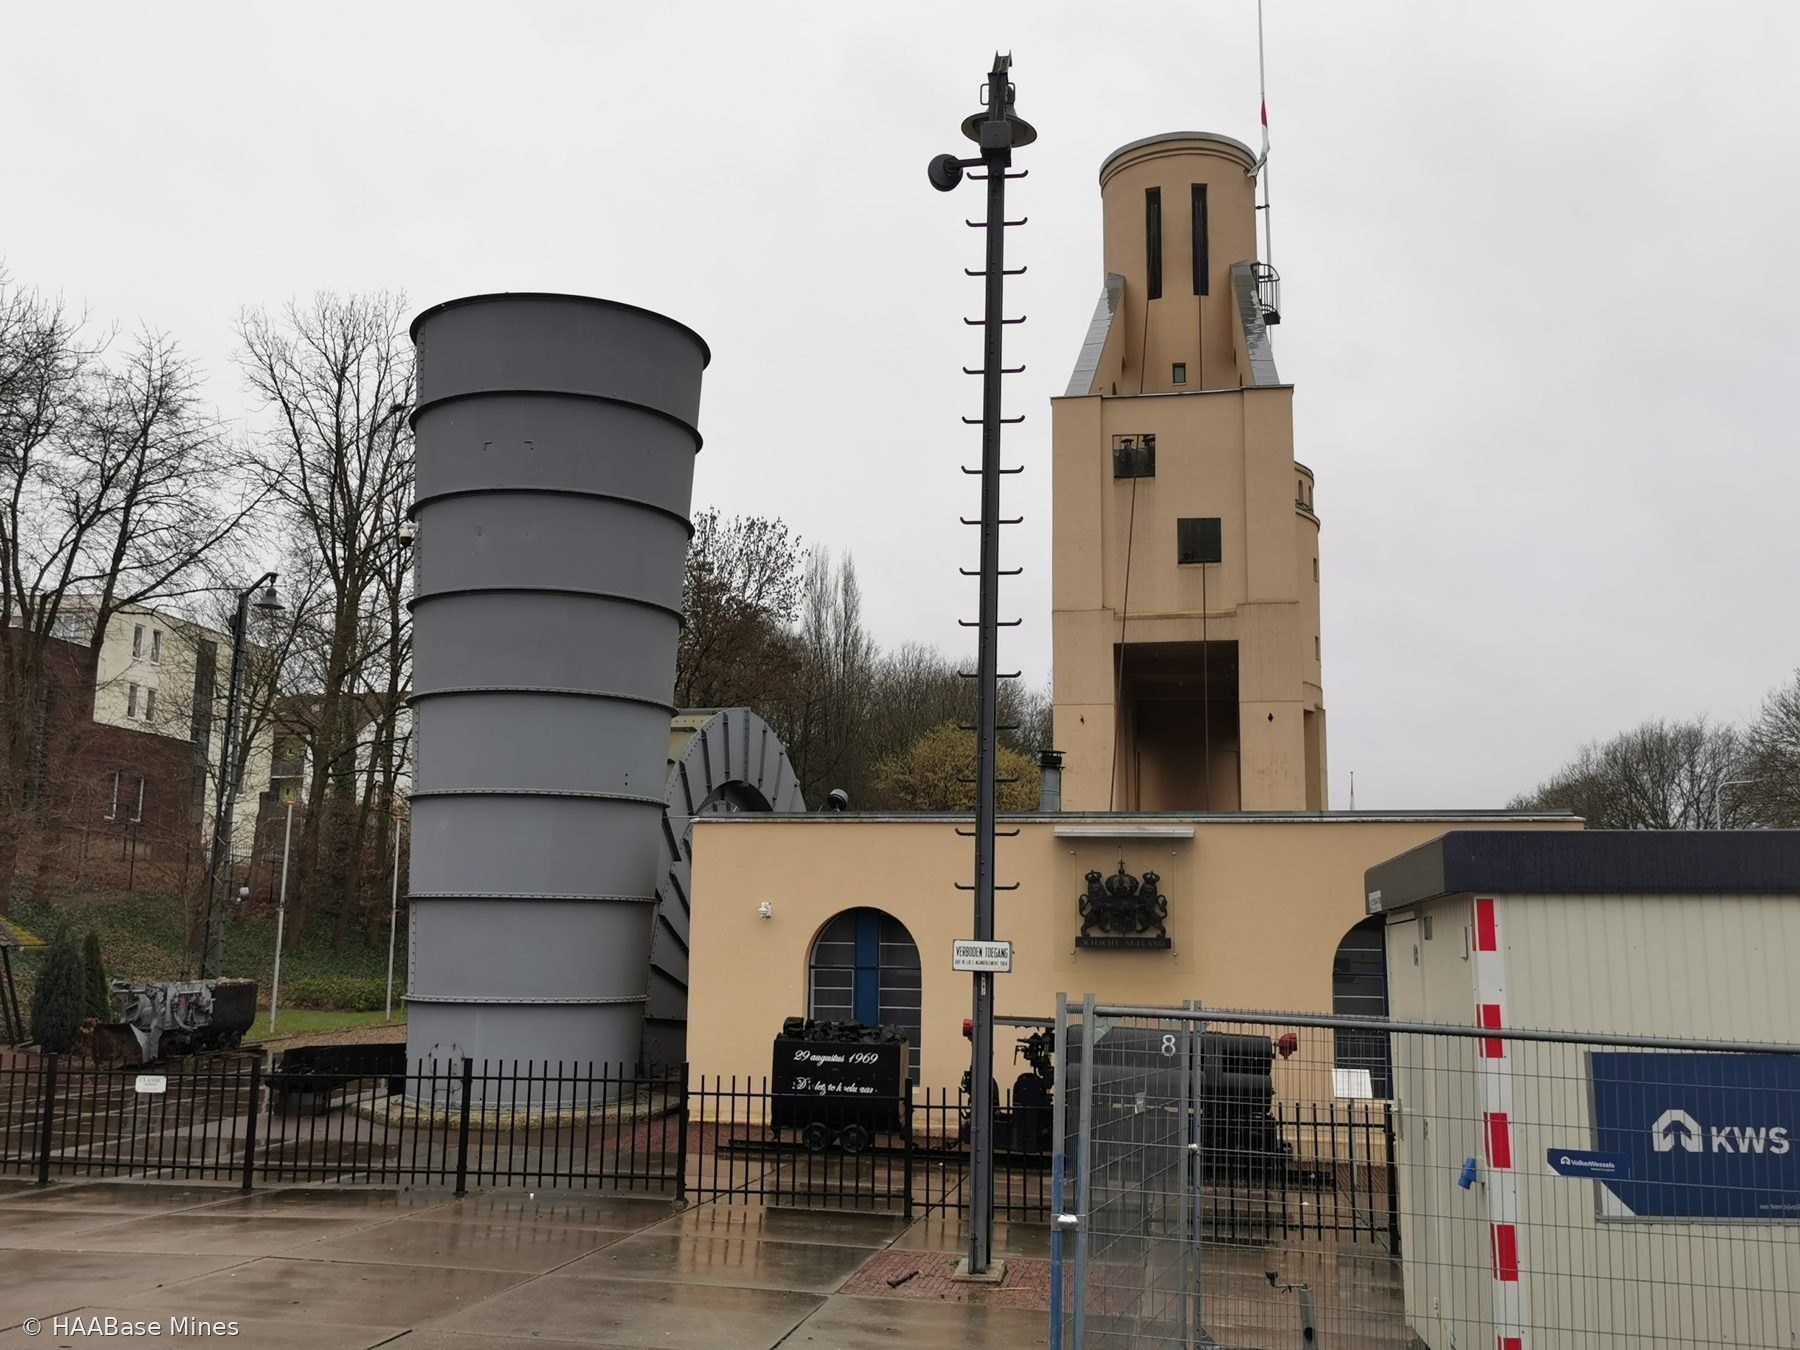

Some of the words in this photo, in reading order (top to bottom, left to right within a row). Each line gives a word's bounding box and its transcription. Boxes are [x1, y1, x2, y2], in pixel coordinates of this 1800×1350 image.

[955, 945, 983, 958] VERBODEN
[985, 946, 1009, 959] TOEGANG
[1161, 1034, 1176, 1057] 8
[793, 1050, 811, 1061] 29
[810, 1053, 845, 1067] augustus
[848, 1052, 879, 1065] 1969
[1710, 1126, 1790, 1155] KWS
[1570, 1159, 1616, 1169] VolkerWessels
